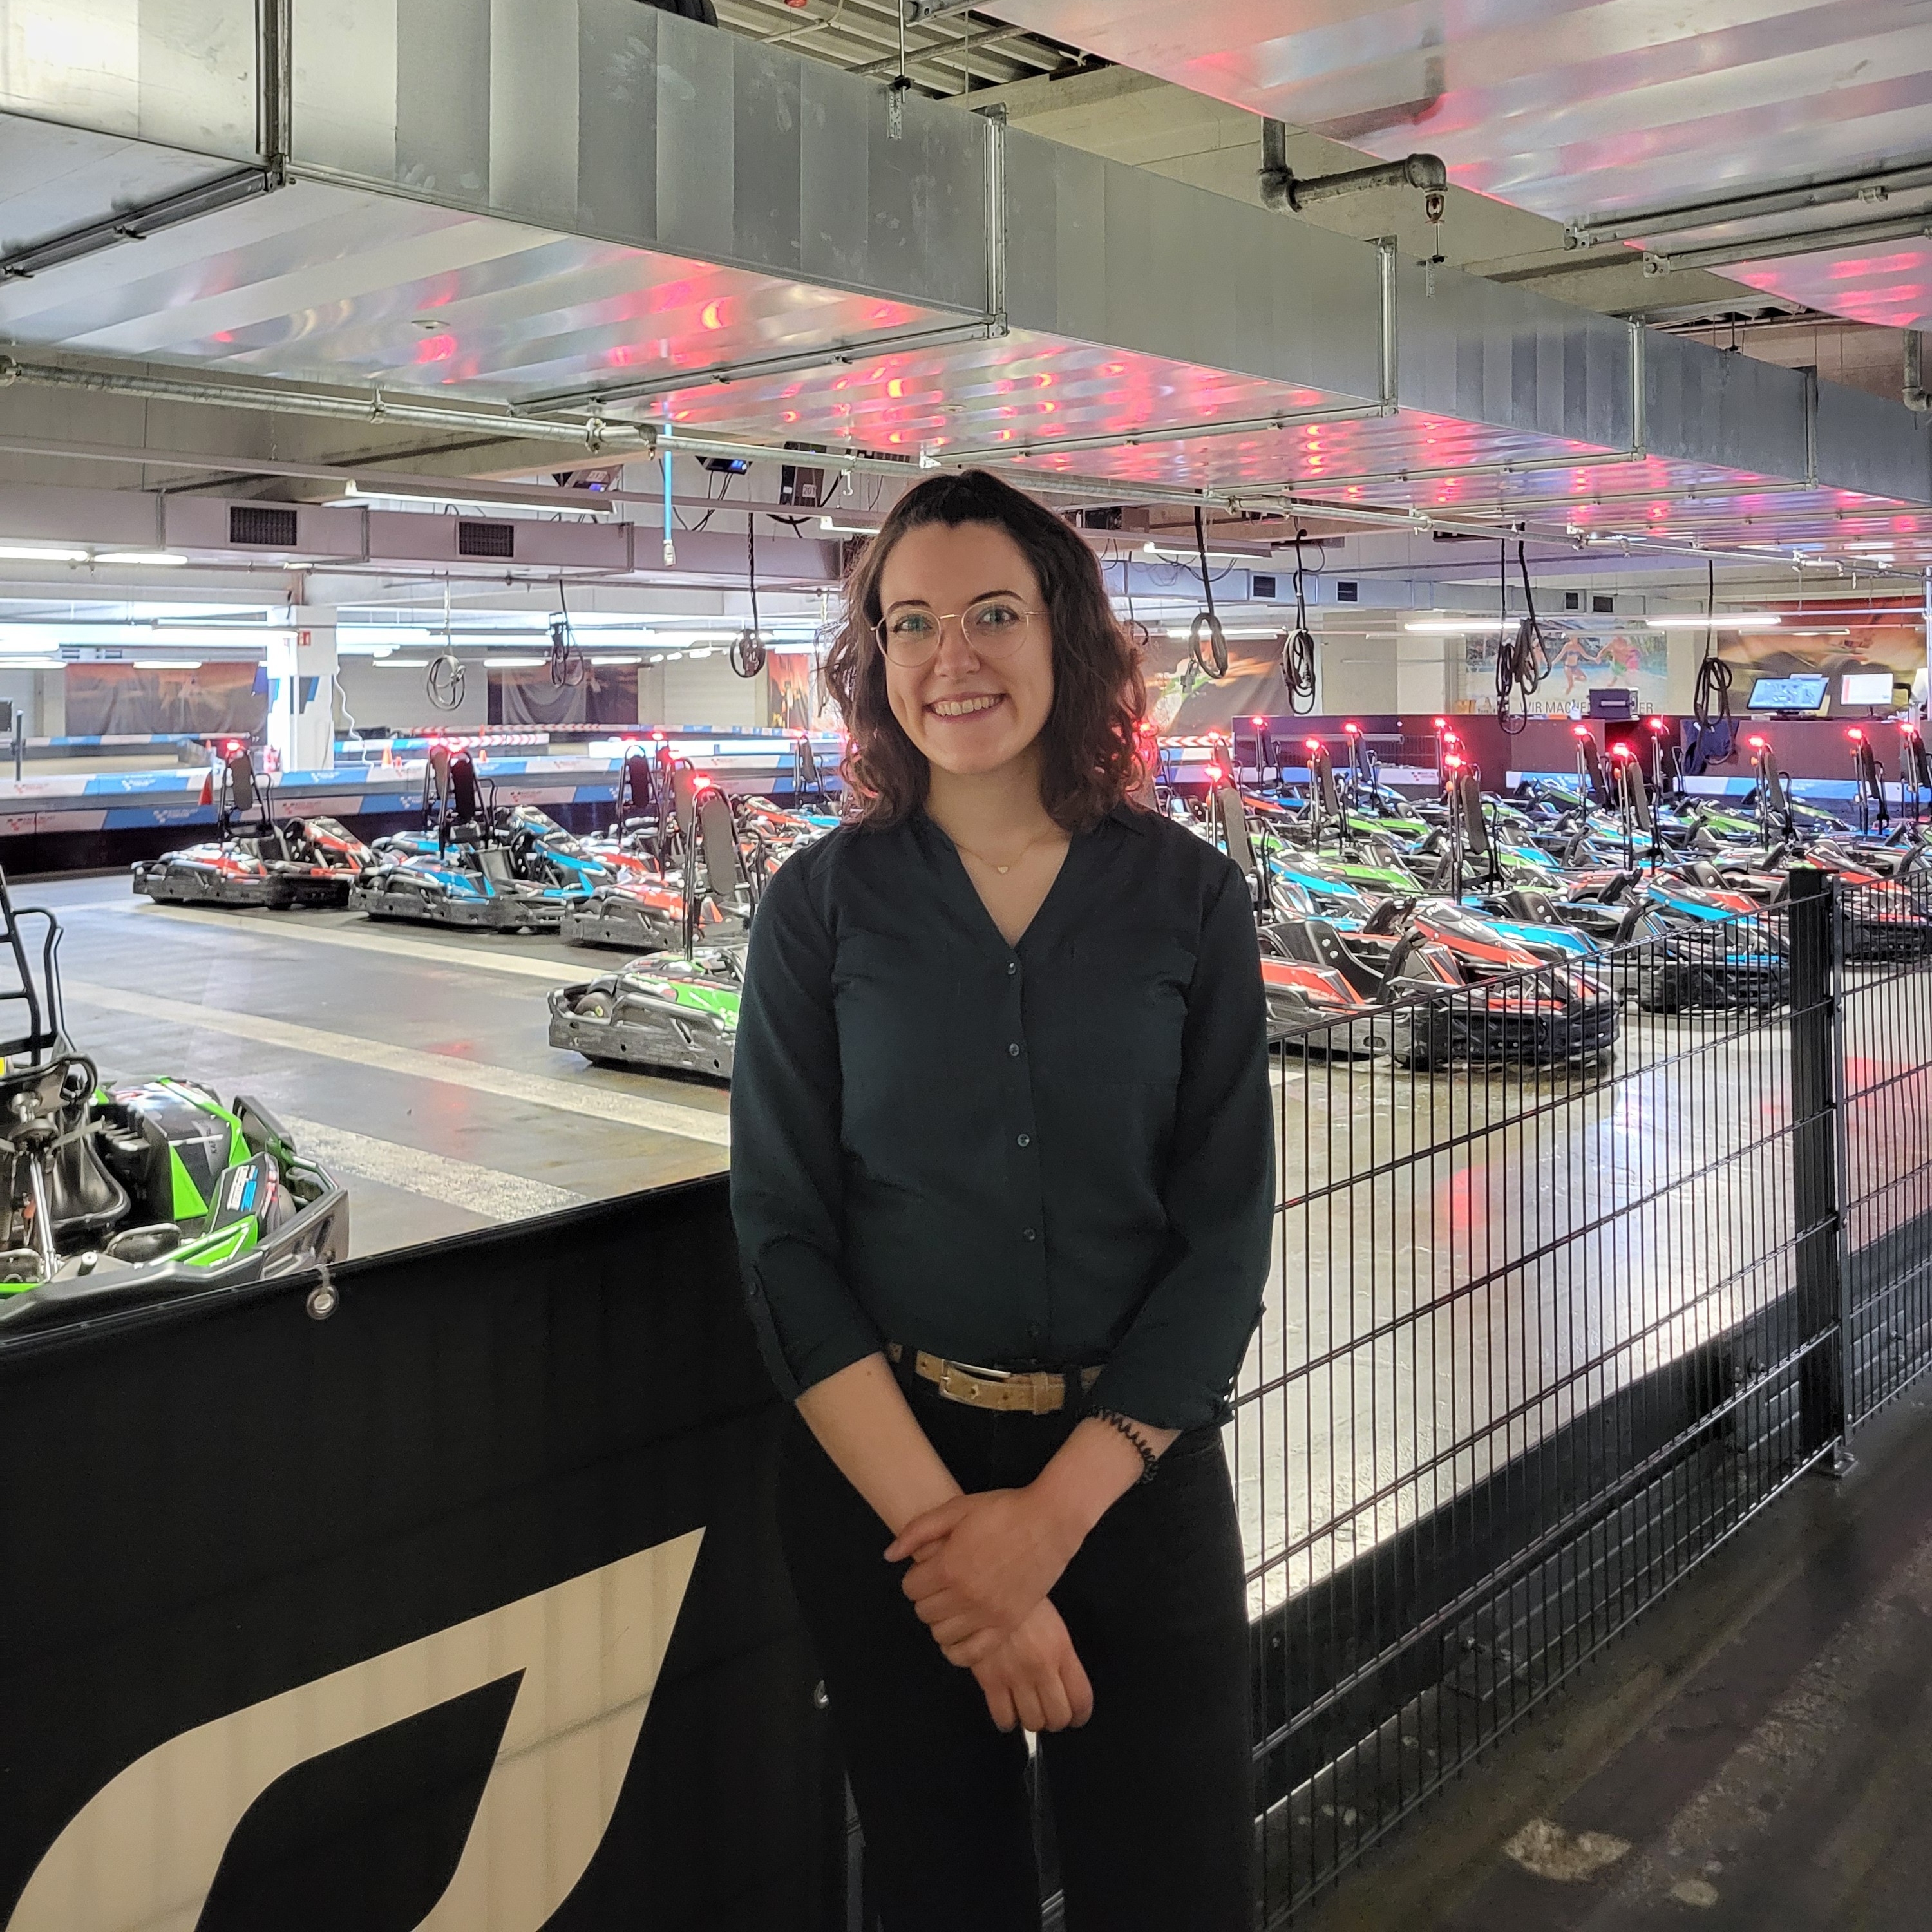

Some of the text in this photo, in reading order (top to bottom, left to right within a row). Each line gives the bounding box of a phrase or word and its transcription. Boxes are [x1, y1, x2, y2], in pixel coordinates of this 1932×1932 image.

[1520, 701, 1542, 713] WIR
[1639, 702, 1653, 714] ER
[1685, 887, 1707, 900] 13
[1458, 919, 1484, 934] 10
